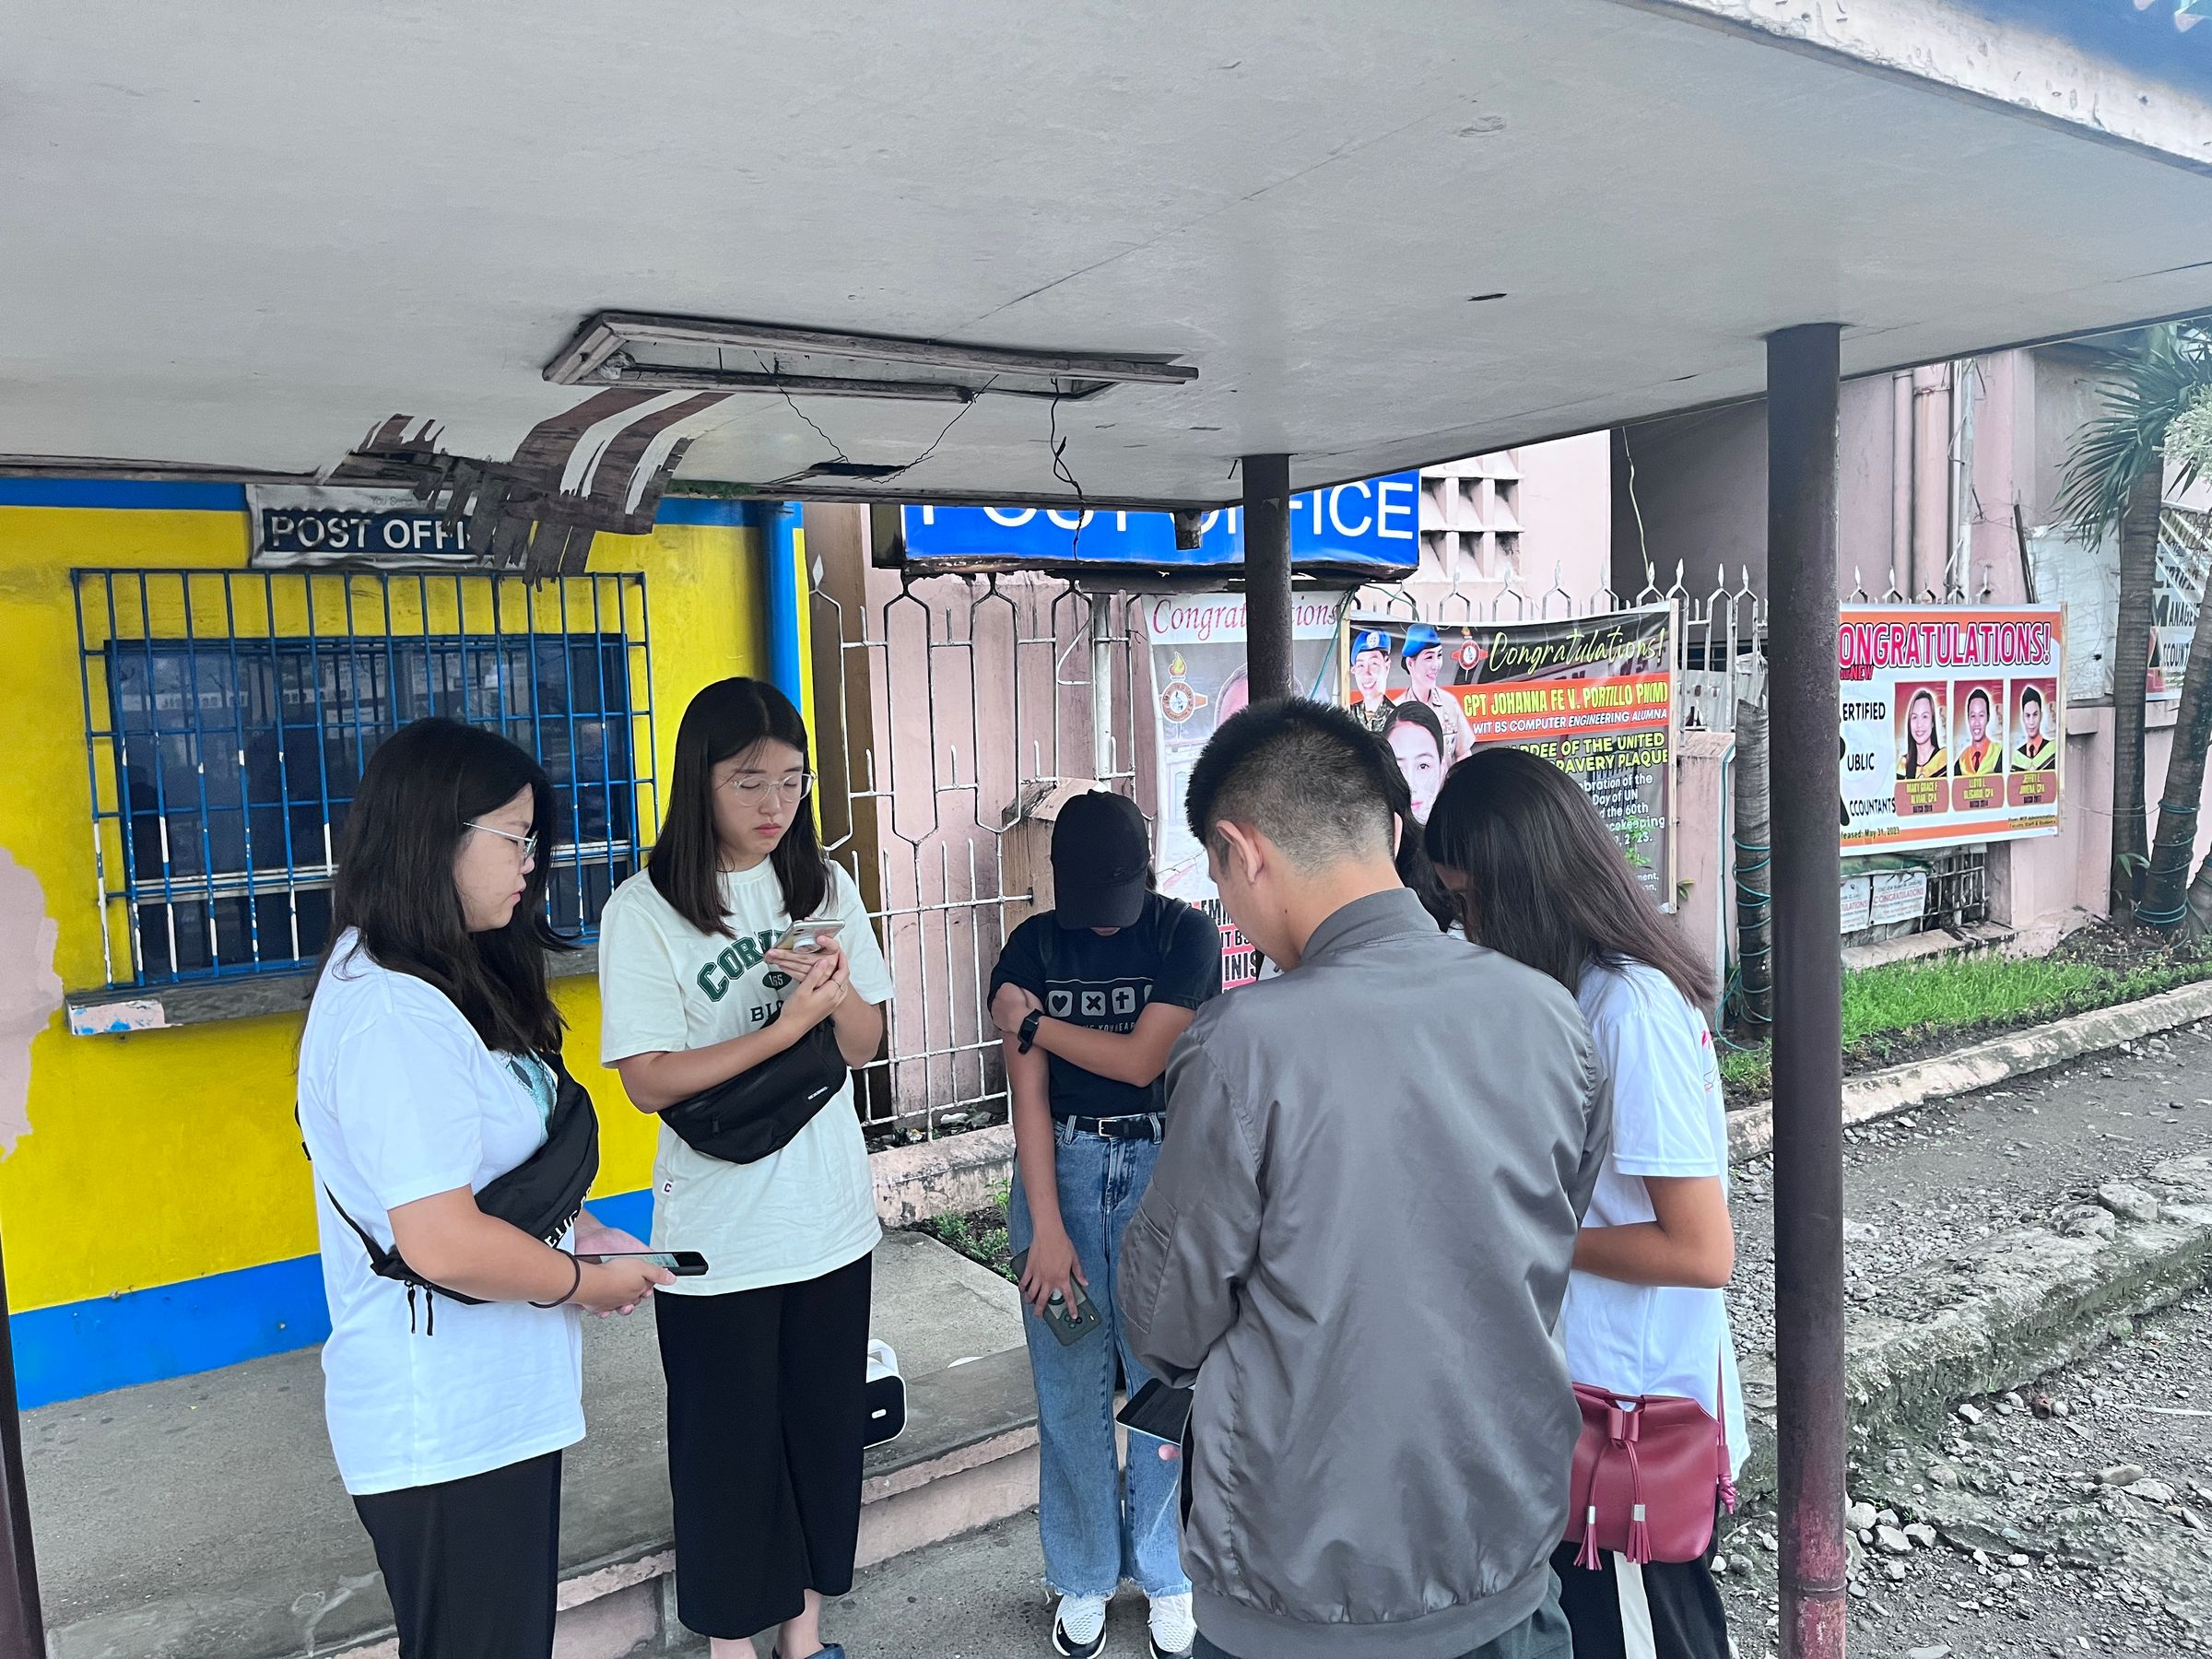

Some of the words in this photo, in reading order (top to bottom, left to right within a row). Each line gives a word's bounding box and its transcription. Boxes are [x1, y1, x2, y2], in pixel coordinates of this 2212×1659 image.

[1169, 481, 1413, 540] ICE
[271, 516, 371, 548] POST
[382, 519, 471, 550] OFFI
[1153, 599, 1336, 641] Congrations
[1488, 626, 1665, 676] Congratulations!
[1840, 622, 2051, 668] ONGRATULATIONS!
[1850, 665, 1874, 680] NEW
[1464, 693, 1488, 717] CPT
[1490, 689, 1547, 716] JOHANNA
[1551, 688, 1565, 712] FE
[1567, 688, 1581, 710] V.
[1583, 685, 1632, 709] PORTILLO
[1841, 702, 1886, 721] ERTIFIED
[1473, 722, 1493, 735] WIT
[1494, 720, 1508, 734] BS
[1510, 716, 1566, 733] COMPUTER
[1568, 711, 1630, 728] ENGINEERING
[1631, 708, 1667, 723] ALUMNA
[1560, 740, 1580, 756] OF
[1583, 736, 1613, 754] THE
[1618, 732, 1665, 750] UNITED
[1550, 755, 1615, 774] RAVERY
[1618, 748, 1668, 769] PLAQUE
[1846, 753, 1875, 771] UBLIC
[1622, 774, 1633, 787] of
[1634, 773, 1653, 785] the
[1593, 794, 1611, 806] Day
[1612, 790, 1622, 802] of
[1624, 788, 1638, 801] UN
[1847, 796, 1896, 818] CCOUNTANTS
[1607, 806, 1622, 818] the
[1626, 802, 1649, 815] 60th
[1606, 816, 1665, 831] cekeeping
[1865, 829, 1876, 839] May
[1624, 831, 1653, 845] 223.
